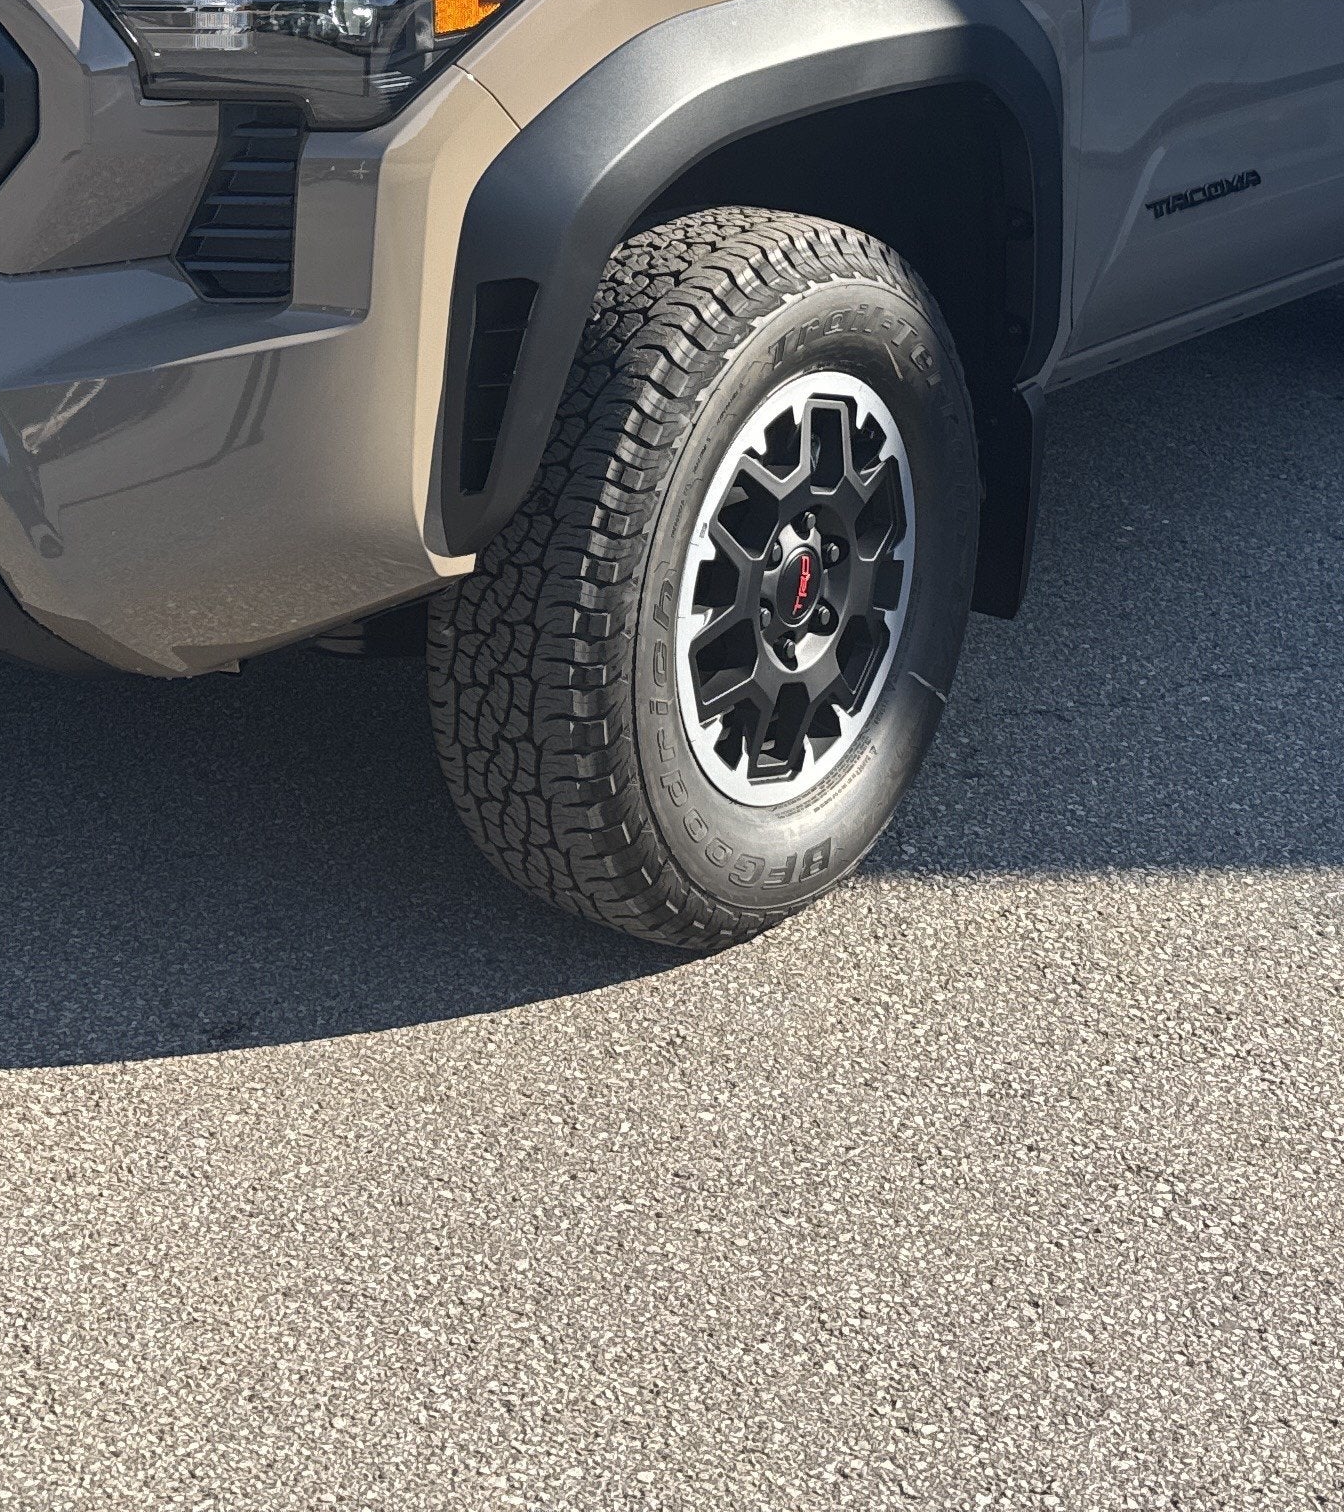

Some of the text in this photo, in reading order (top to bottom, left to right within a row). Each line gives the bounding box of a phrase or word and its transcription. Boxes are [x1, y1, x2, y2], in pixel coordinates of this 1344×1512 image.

[1144, 169, 1262, 219] TACOMA
[792, 555, 811, 615] TRD
[649, 577, 833, 888] BFGoodrich
